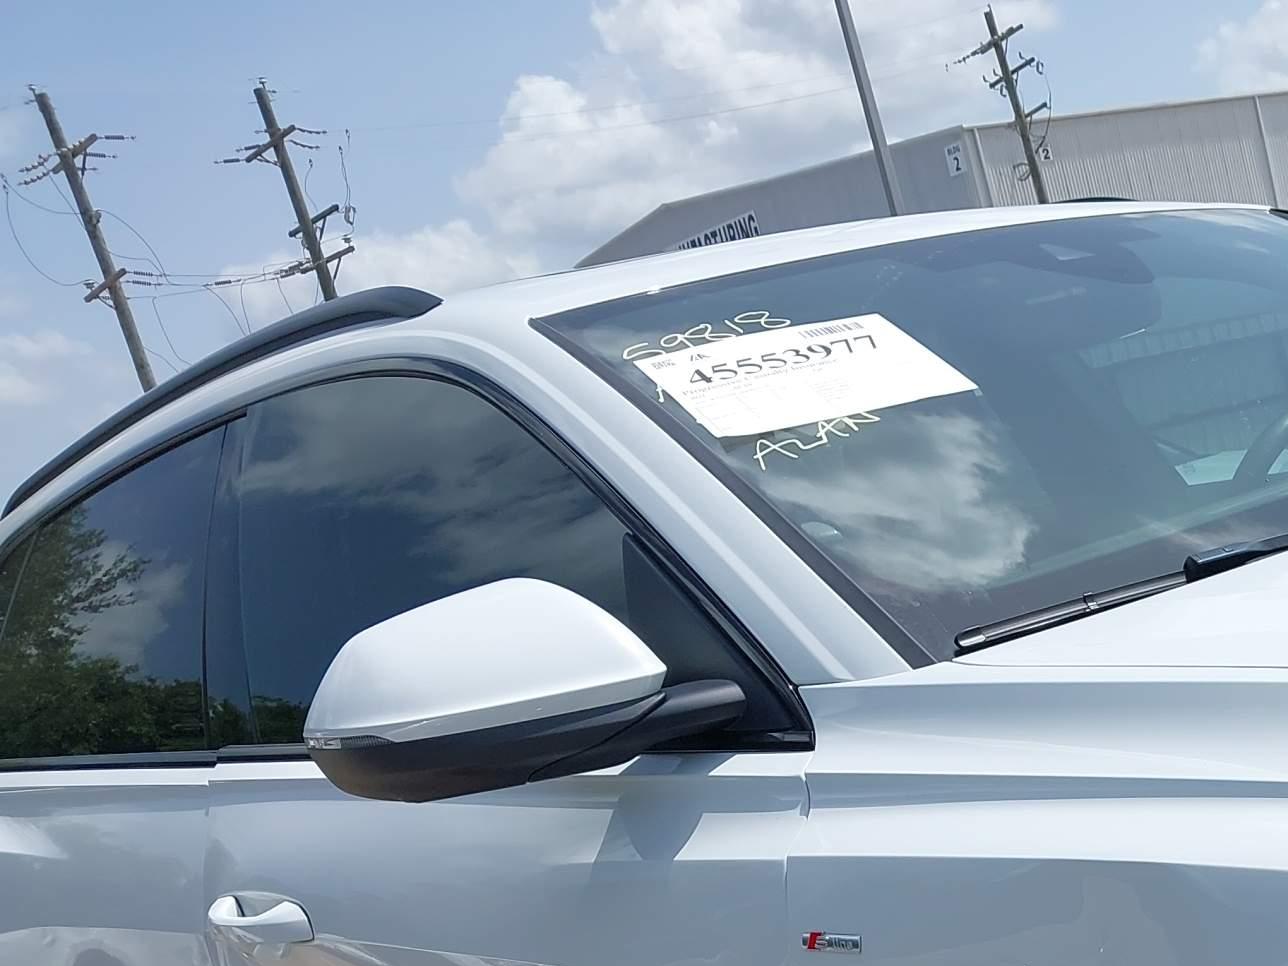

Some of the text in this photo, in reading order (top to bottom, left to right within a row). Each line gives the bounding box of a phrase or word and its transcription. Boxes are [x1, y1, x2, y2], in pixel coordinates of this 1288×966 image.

[1042, 148, 1051, 160] 2
[953, 157, 962, 172] 2
[690, 334, 878, 384] 45553977
